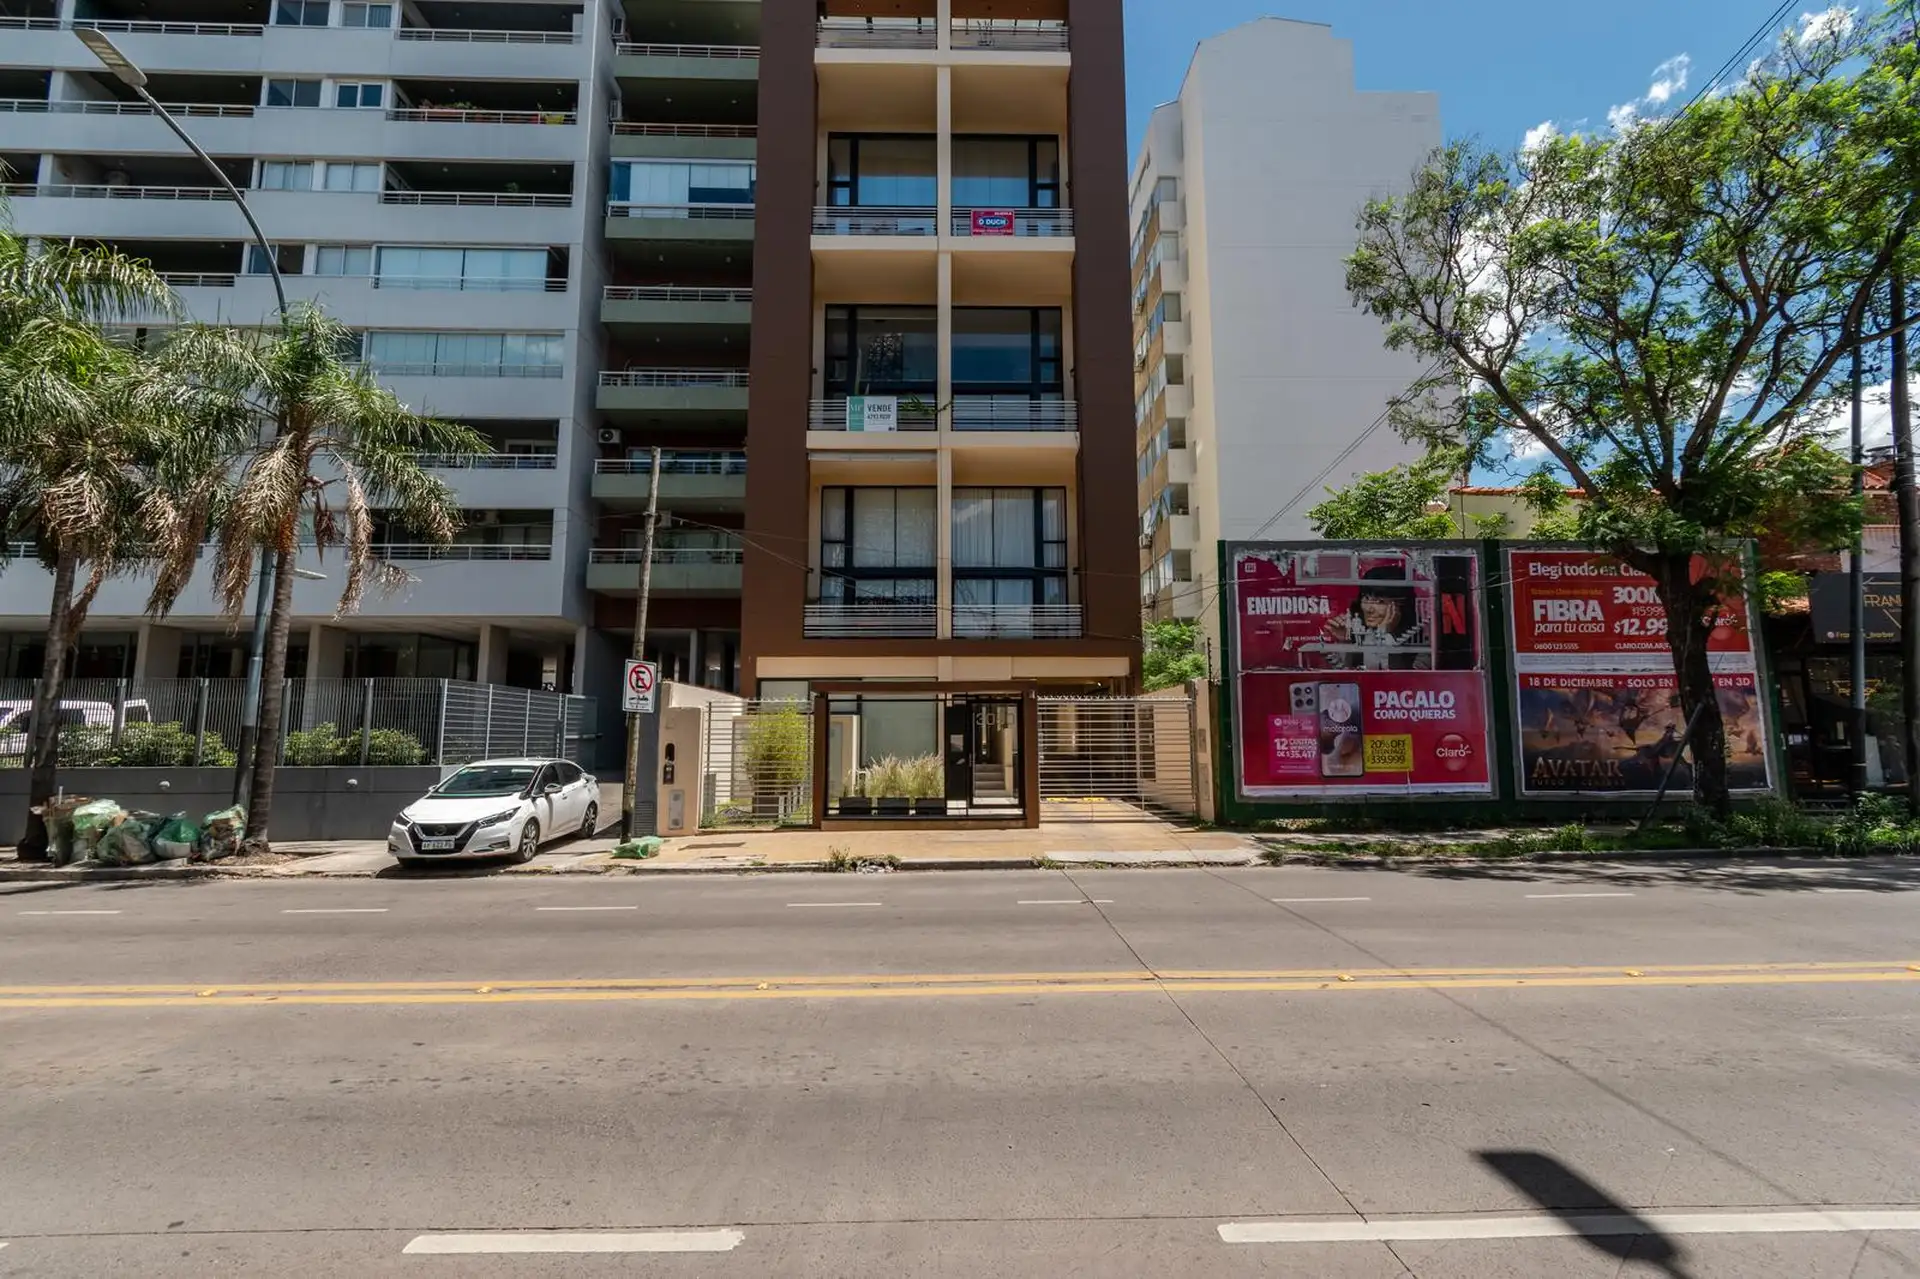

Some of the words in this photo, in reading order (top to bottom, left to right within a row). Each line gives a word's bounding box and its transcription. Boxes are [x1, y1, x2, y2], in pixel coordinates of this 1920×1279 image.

[867, 404, 892, 412] VENDE
[1563, 562, 1598, 576] todo
[1247, 595, 1331, 615] ENVIDIOSA
[1533, 599, 1605, 621] FIBRA
[1442, 593, 1466, 634] N
[1534, 622, 1562, 636] para
[1564, 622, 1577, 633] tu
[1578, 622, 1605, 633] casa
[1528, 677, 1540, 686] 18
[1543, 677, 1557, 687] DE
[1560, 678, 1614, 687] DICIEMBRE
[1627, 678, 1655, 688] SOLO
[1659, 678, 1674, 687] EN
[1719, 677, 1732, 686] EN
[1736, 677, 1751, 686] 3D
[1374, 690, 1455, 708] PAGALO
[1374, 709, 1408, 719] COMO
[1409, 709, 1456, 721] QUIERAS
[1274, 738, 1288, 750] 12
[1436, 744, 1468, 757] Claro
[1532, 756, 1623, 777] AVATAR
